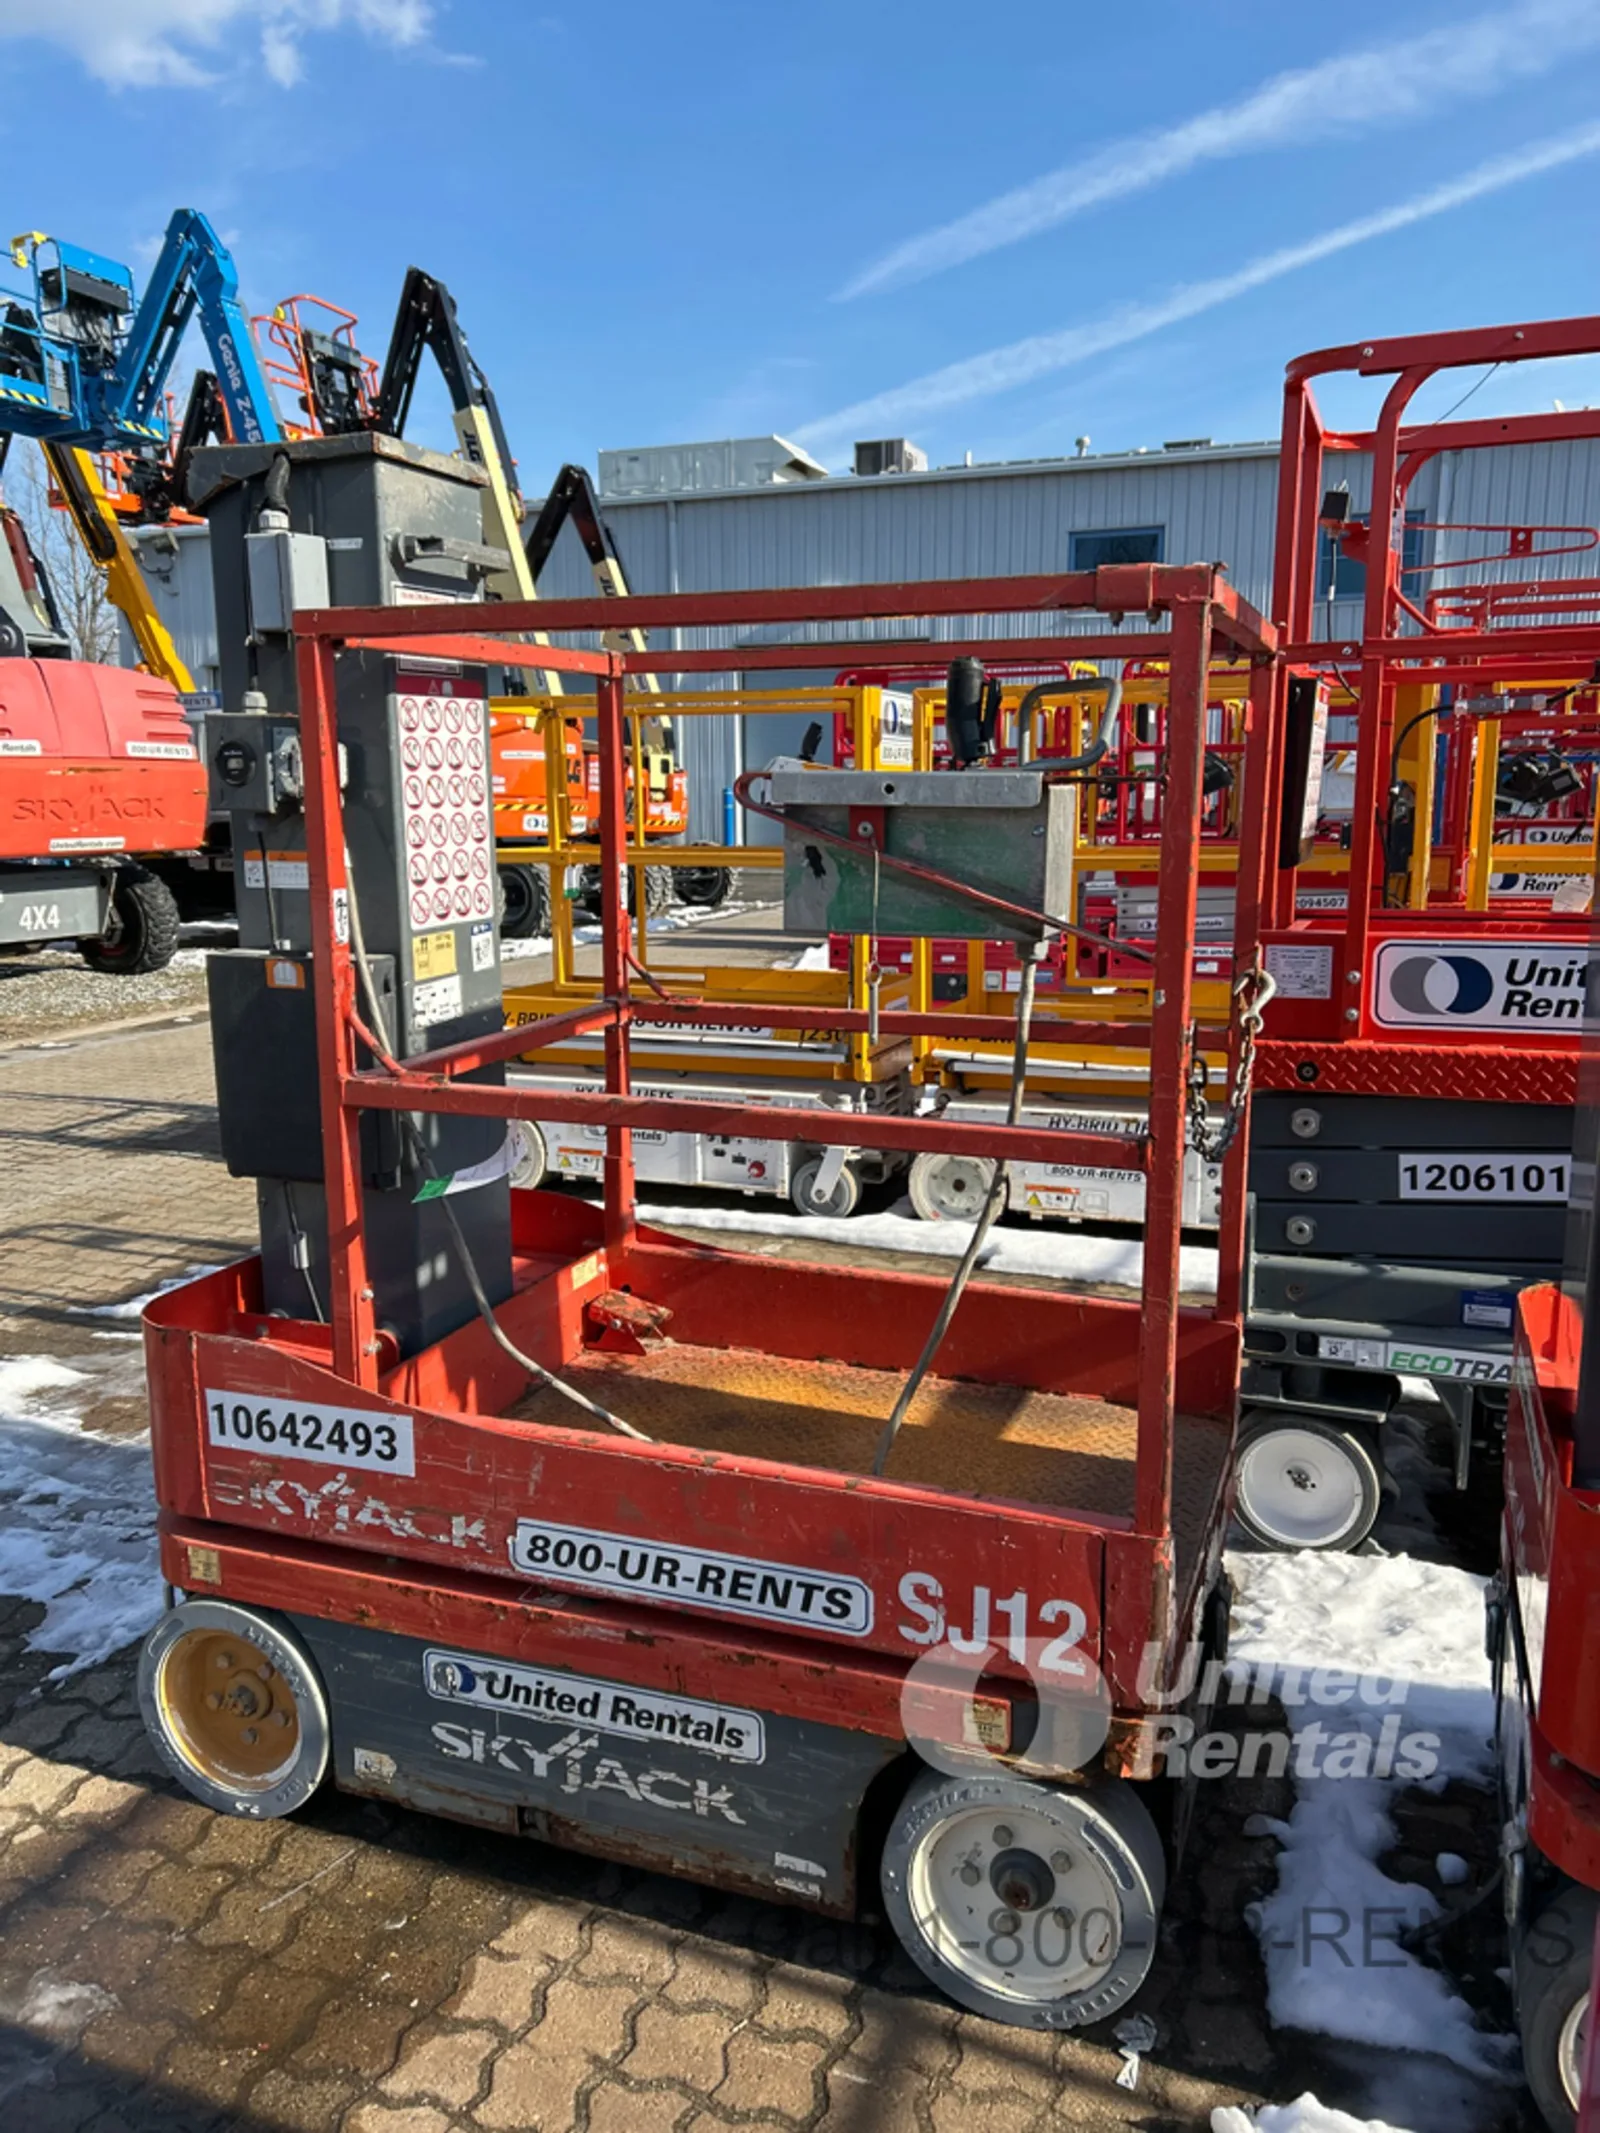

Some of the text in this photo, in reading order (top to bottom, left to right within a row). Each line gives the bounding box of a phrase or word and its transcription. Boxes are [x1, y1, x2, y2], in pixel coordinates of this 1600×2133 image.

[19, 905, 61, 930] 4X4
[1505, 958, 1588, 988] Unit
[1403, 1164, 1566, 1193] 1206101
[1390, 1351, 1512, 1382] ECOTRA
[212, 1403, 398, 1461] 10642493
[526, 1534, 853, 1620] 800-UR-RENTS
[898, 1571, 1087, 1676] SJ12
[486, 1673, 745, 1748] United Rentals
[431, 1721, 747, 1826] SKYJACK
